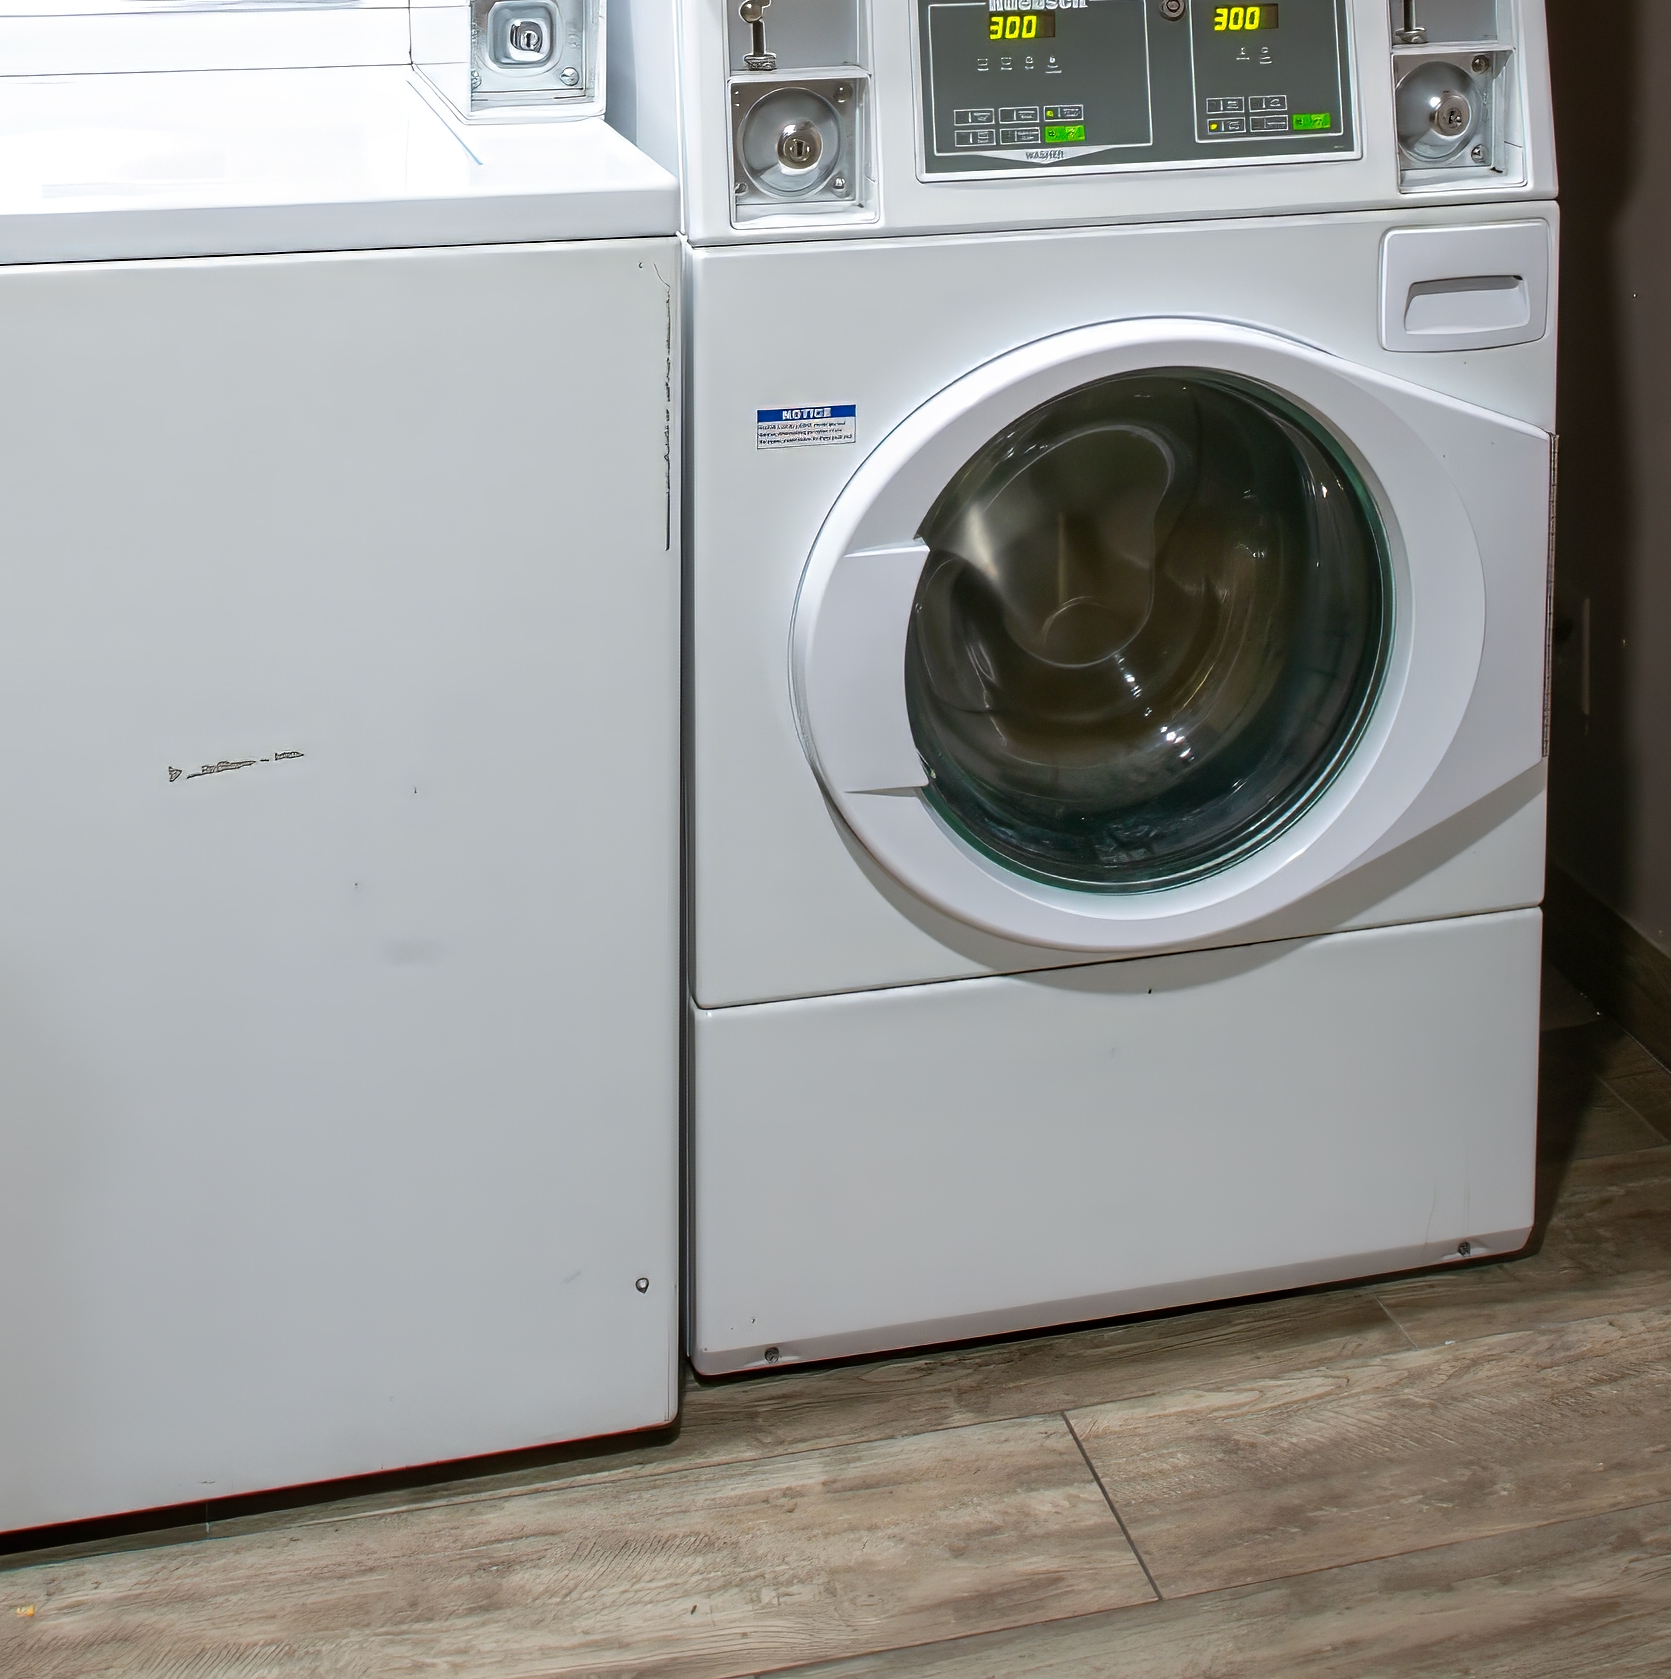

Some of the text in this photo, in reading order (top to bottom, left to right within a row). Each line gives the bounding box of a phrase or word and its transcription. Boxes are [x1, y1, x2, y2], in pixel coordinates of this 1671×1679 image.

[989, 15, 1037, 40] 300
[1213, 6, 1261, 31] 300
[782, 407, 831, 420] NOTICE
